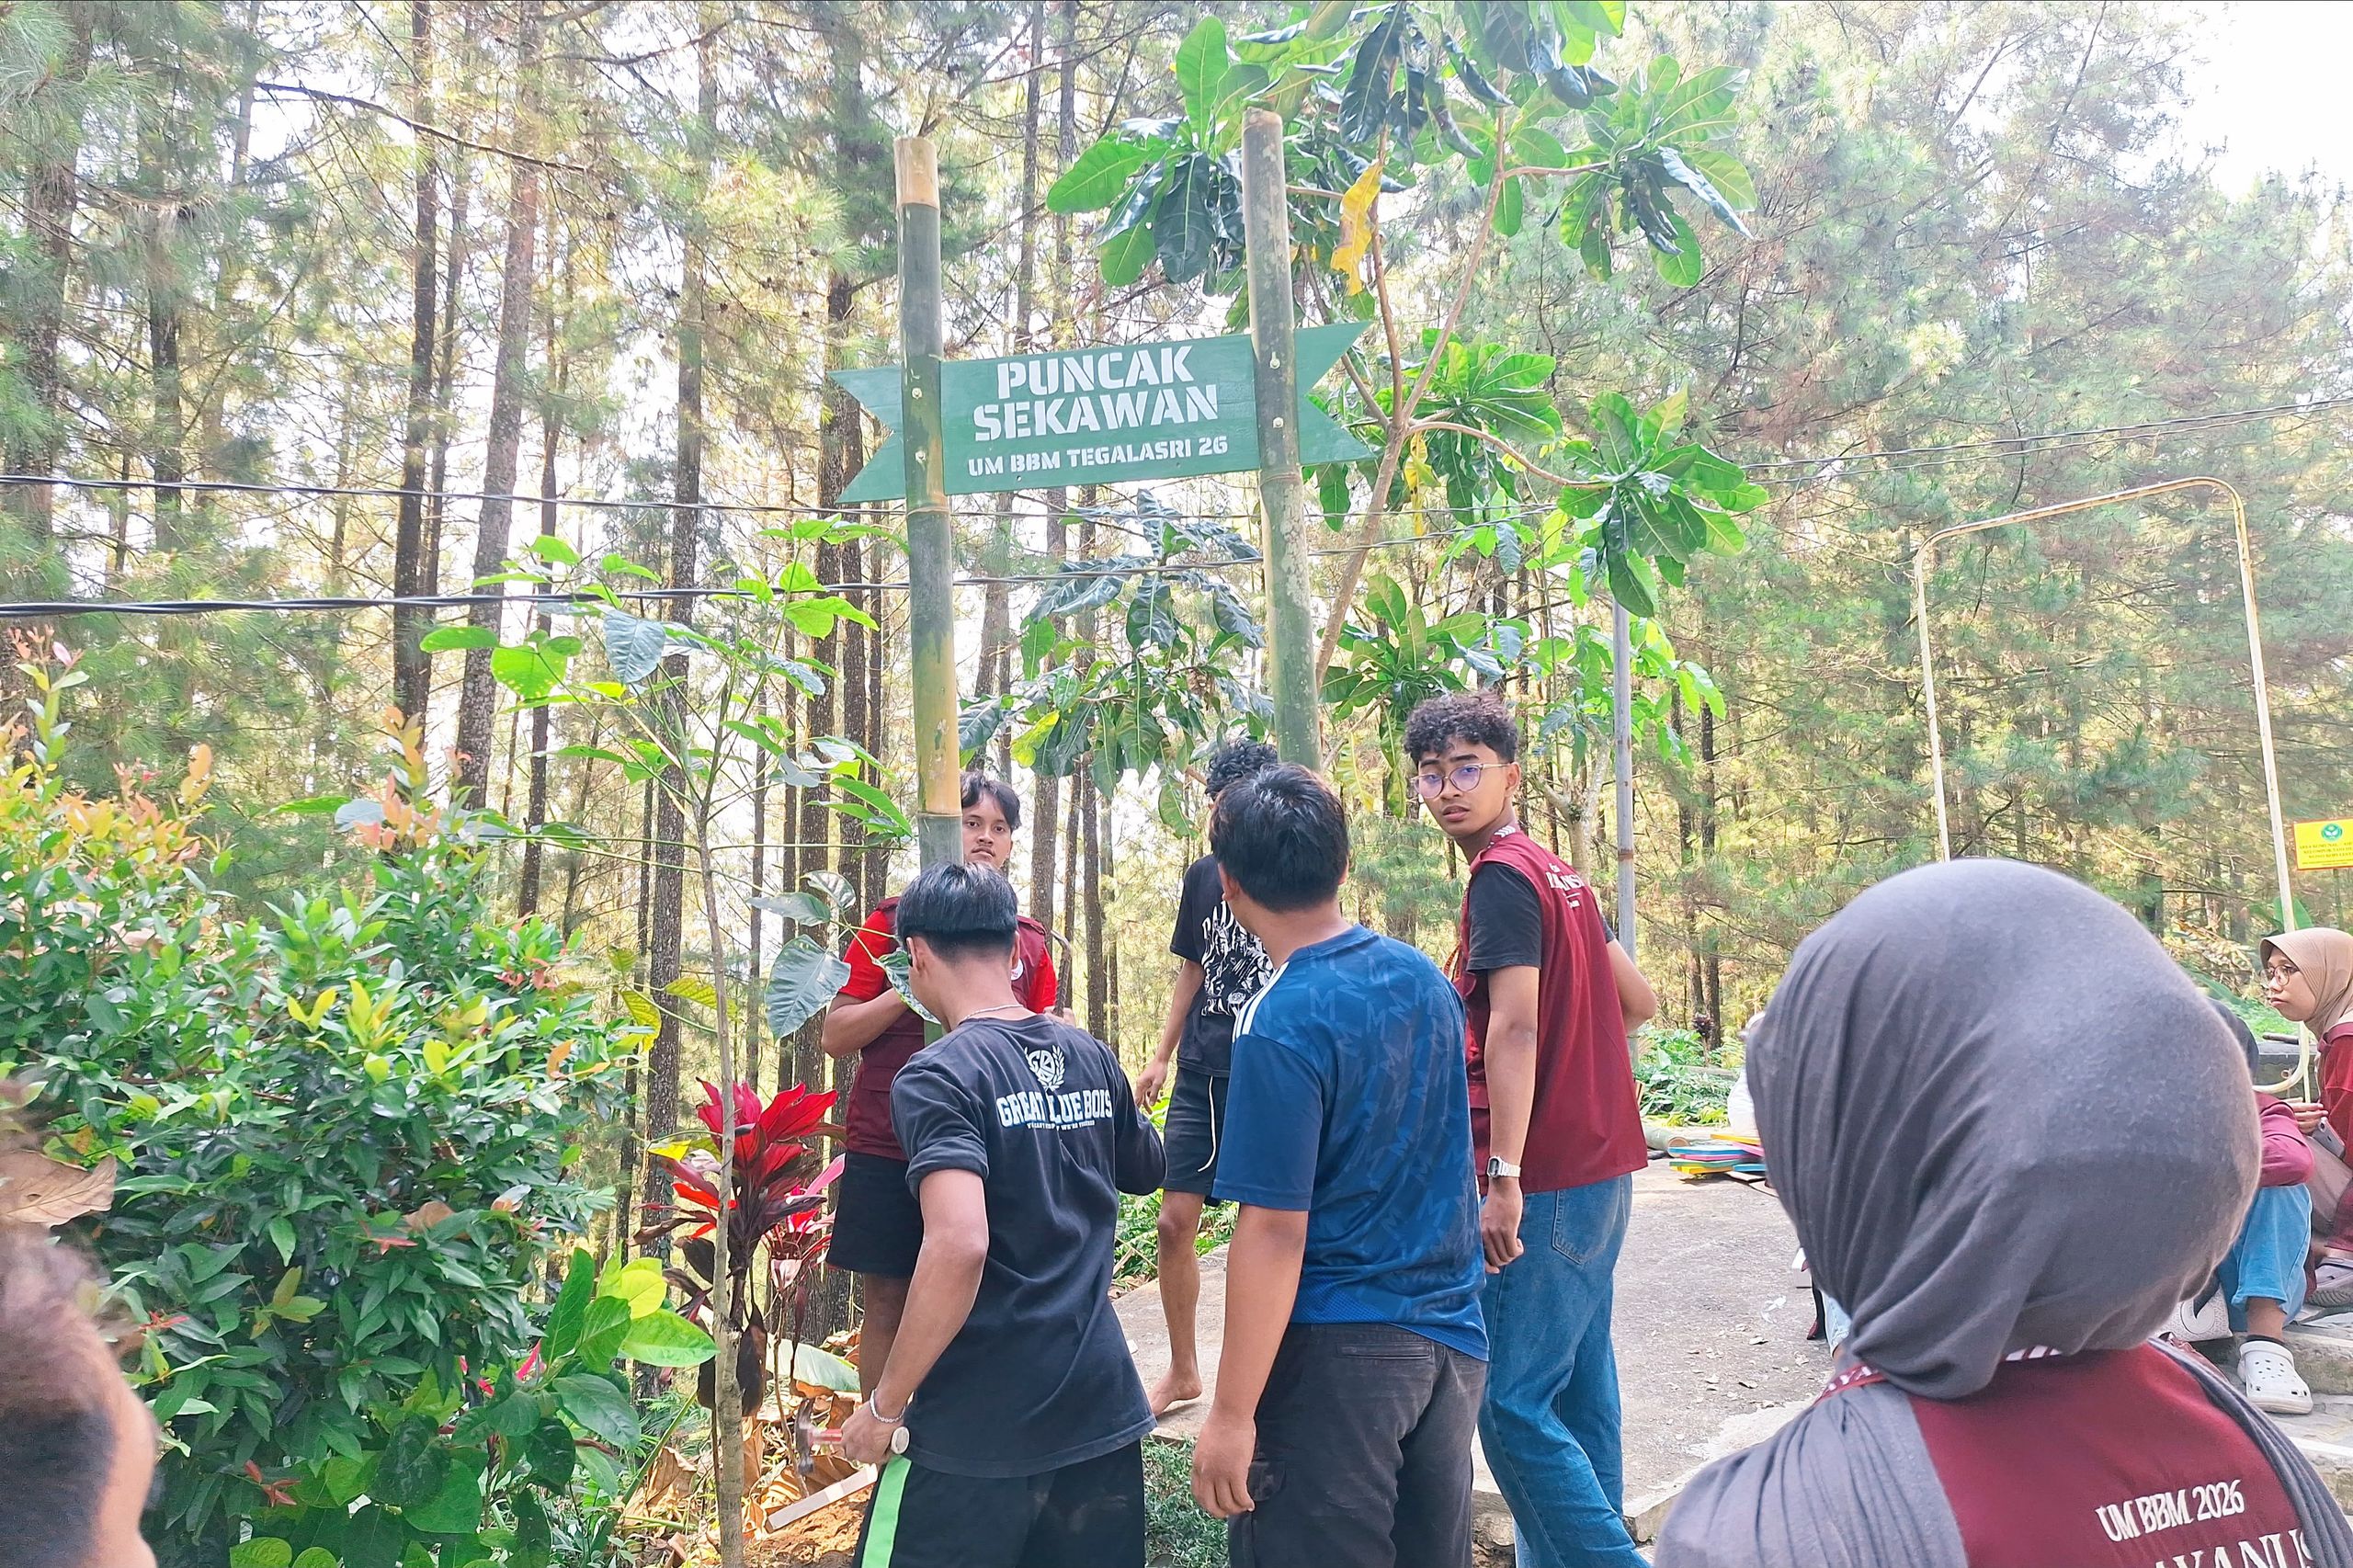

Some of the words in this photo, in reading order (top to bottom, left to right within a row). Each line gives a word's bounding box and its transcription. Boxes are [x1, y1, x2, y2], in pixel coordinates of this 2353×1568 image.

[997, 346, 1194, 399] PUNCAK
[973, 384, 1218, 441] SEKAWAN
[968, 456, 1004, 476] UM
[1010, 450, 1061, 472] BBM
[1066, 439, 1192, 468] TEGALASRI
[1199, 436, 1228, 456] 26
[996, 1091, 1046, 1128] GREAT
[1047, 1091, 1083, 1124] LUE
[1083, 1089, 1113, 1119] BOIS
[2095, 1500, 2141, 1542] UM
[2134, 1489, 2194, 1534] BBM
[2191, 1479, 2245, 1522] 2026
